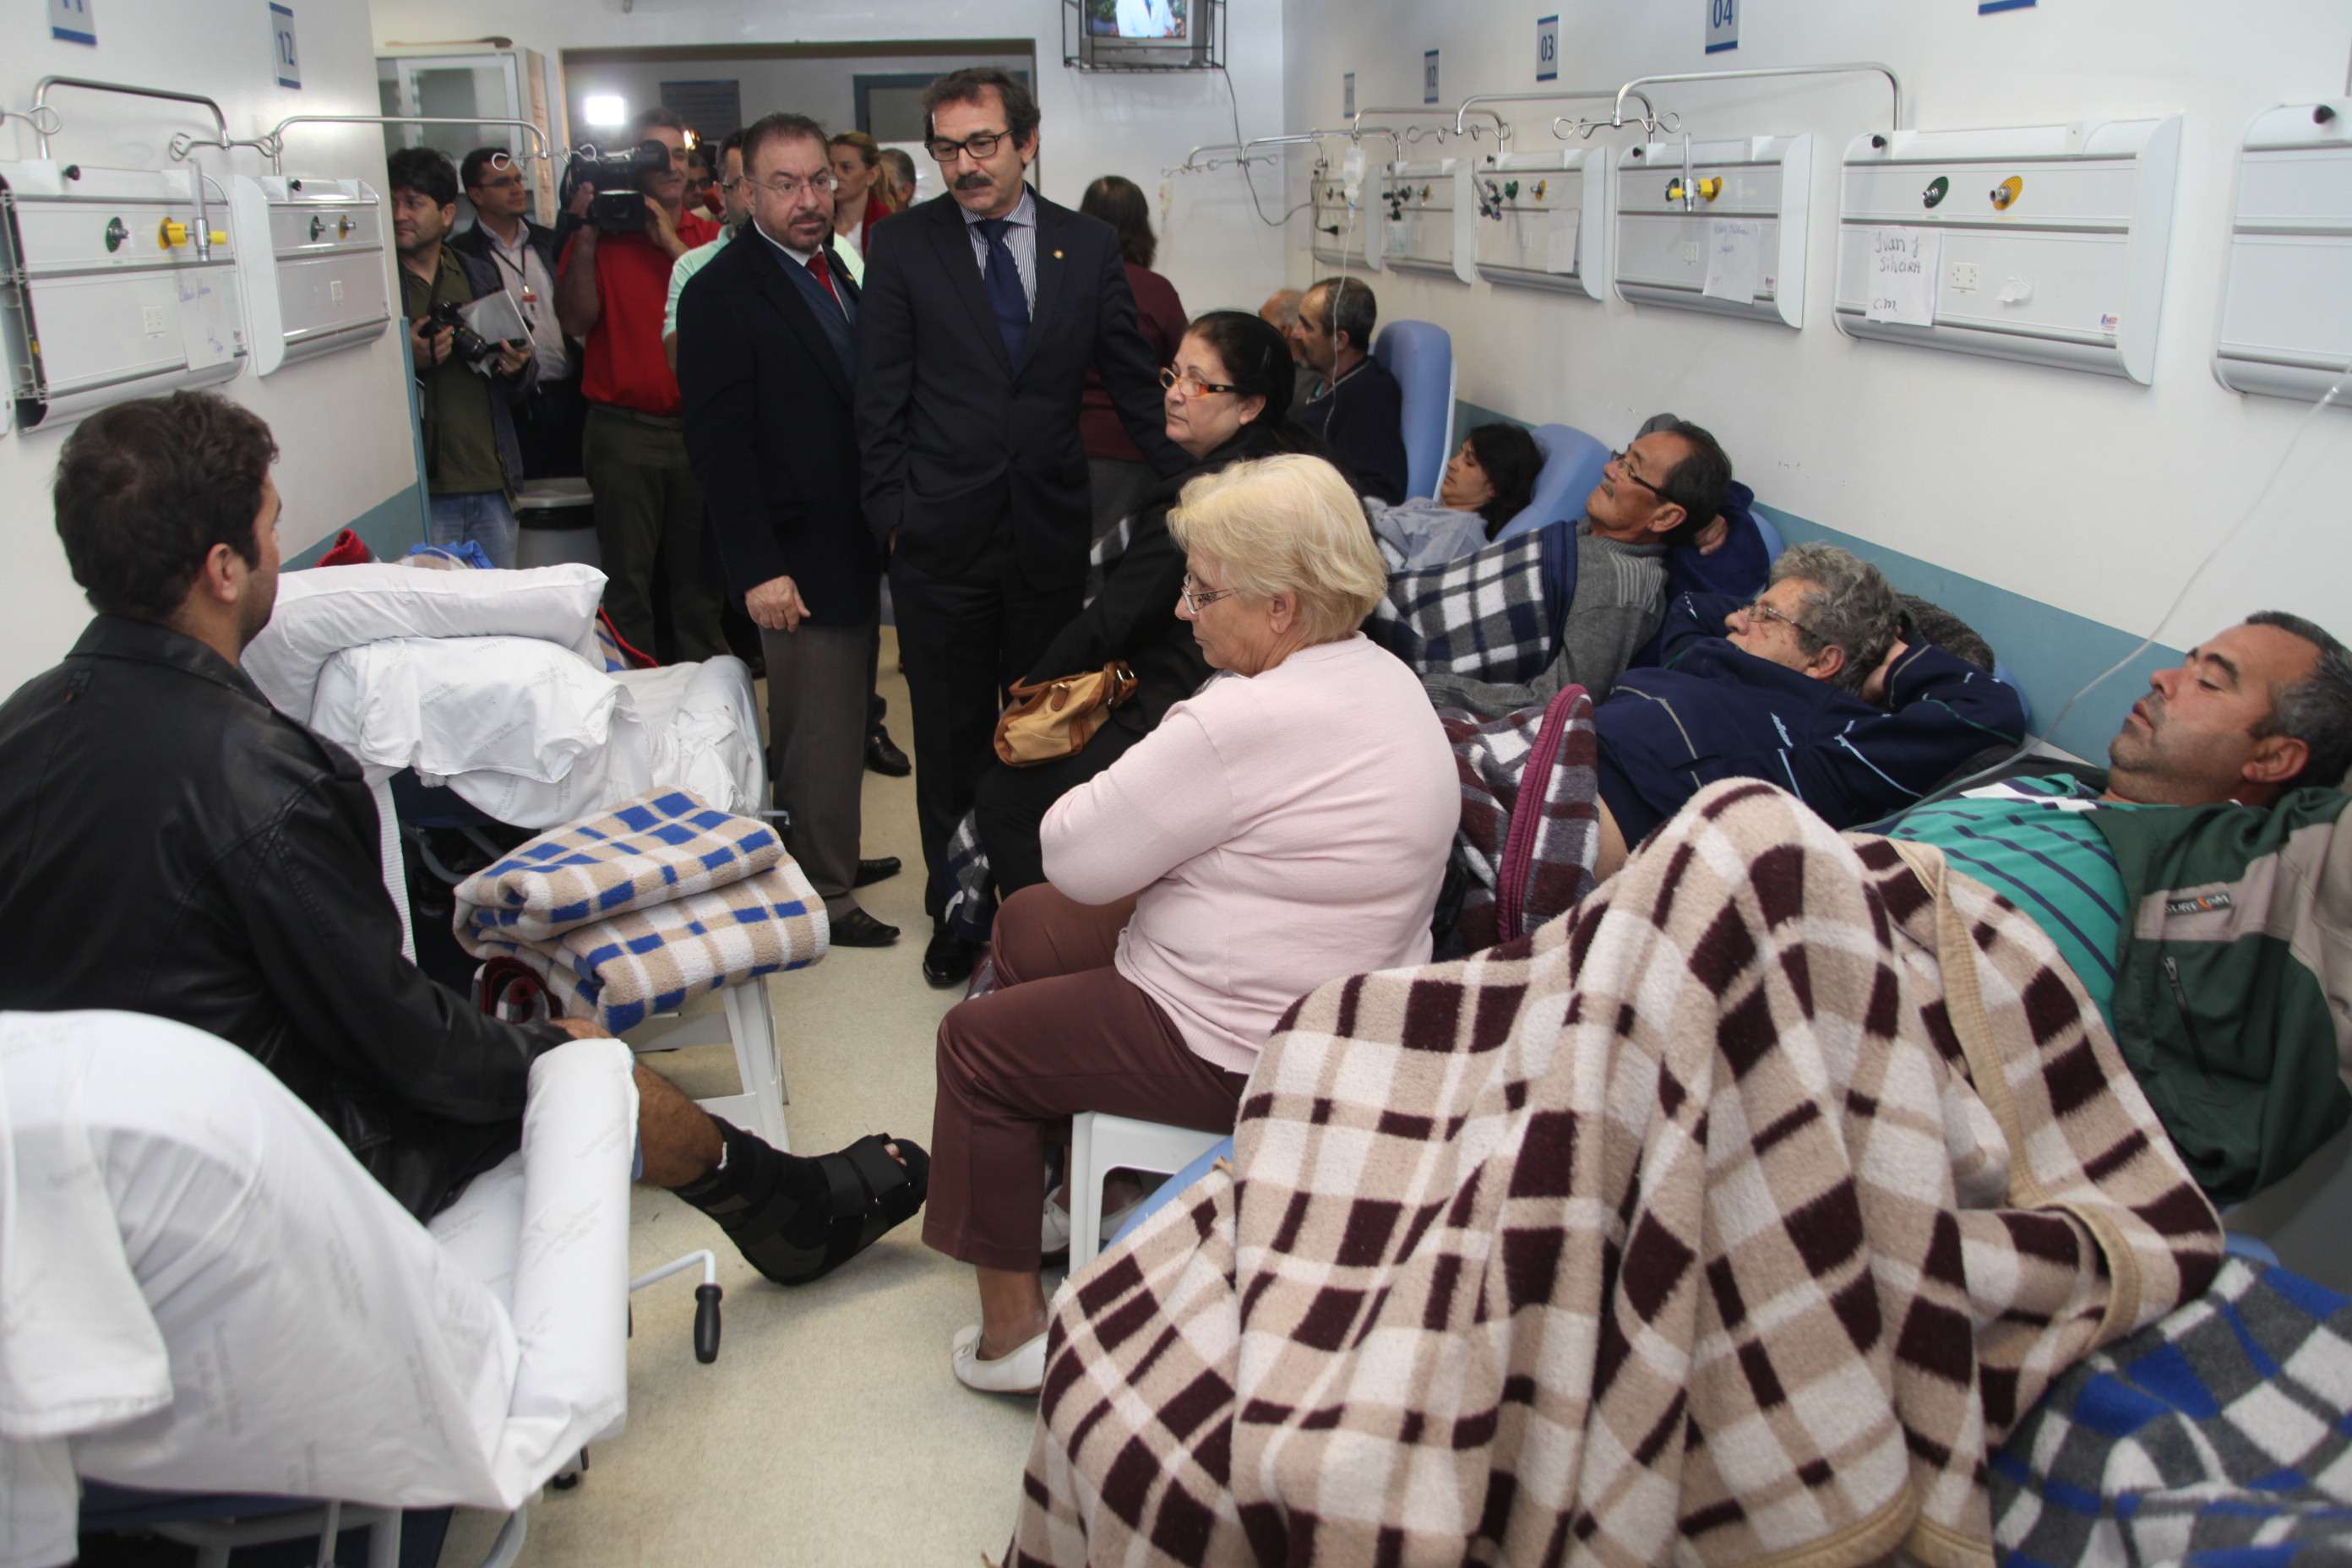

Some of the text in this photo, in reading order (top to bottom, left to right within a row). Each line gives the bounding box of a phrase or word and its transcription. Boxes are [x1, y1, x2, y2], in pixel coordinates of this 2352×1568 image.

[1713, 0, 1733, 28] 04
[278, 30, 295, 66] 12
[1541, 34, 1554, 62] 03
[1427, 65, 1436, 88] 02
